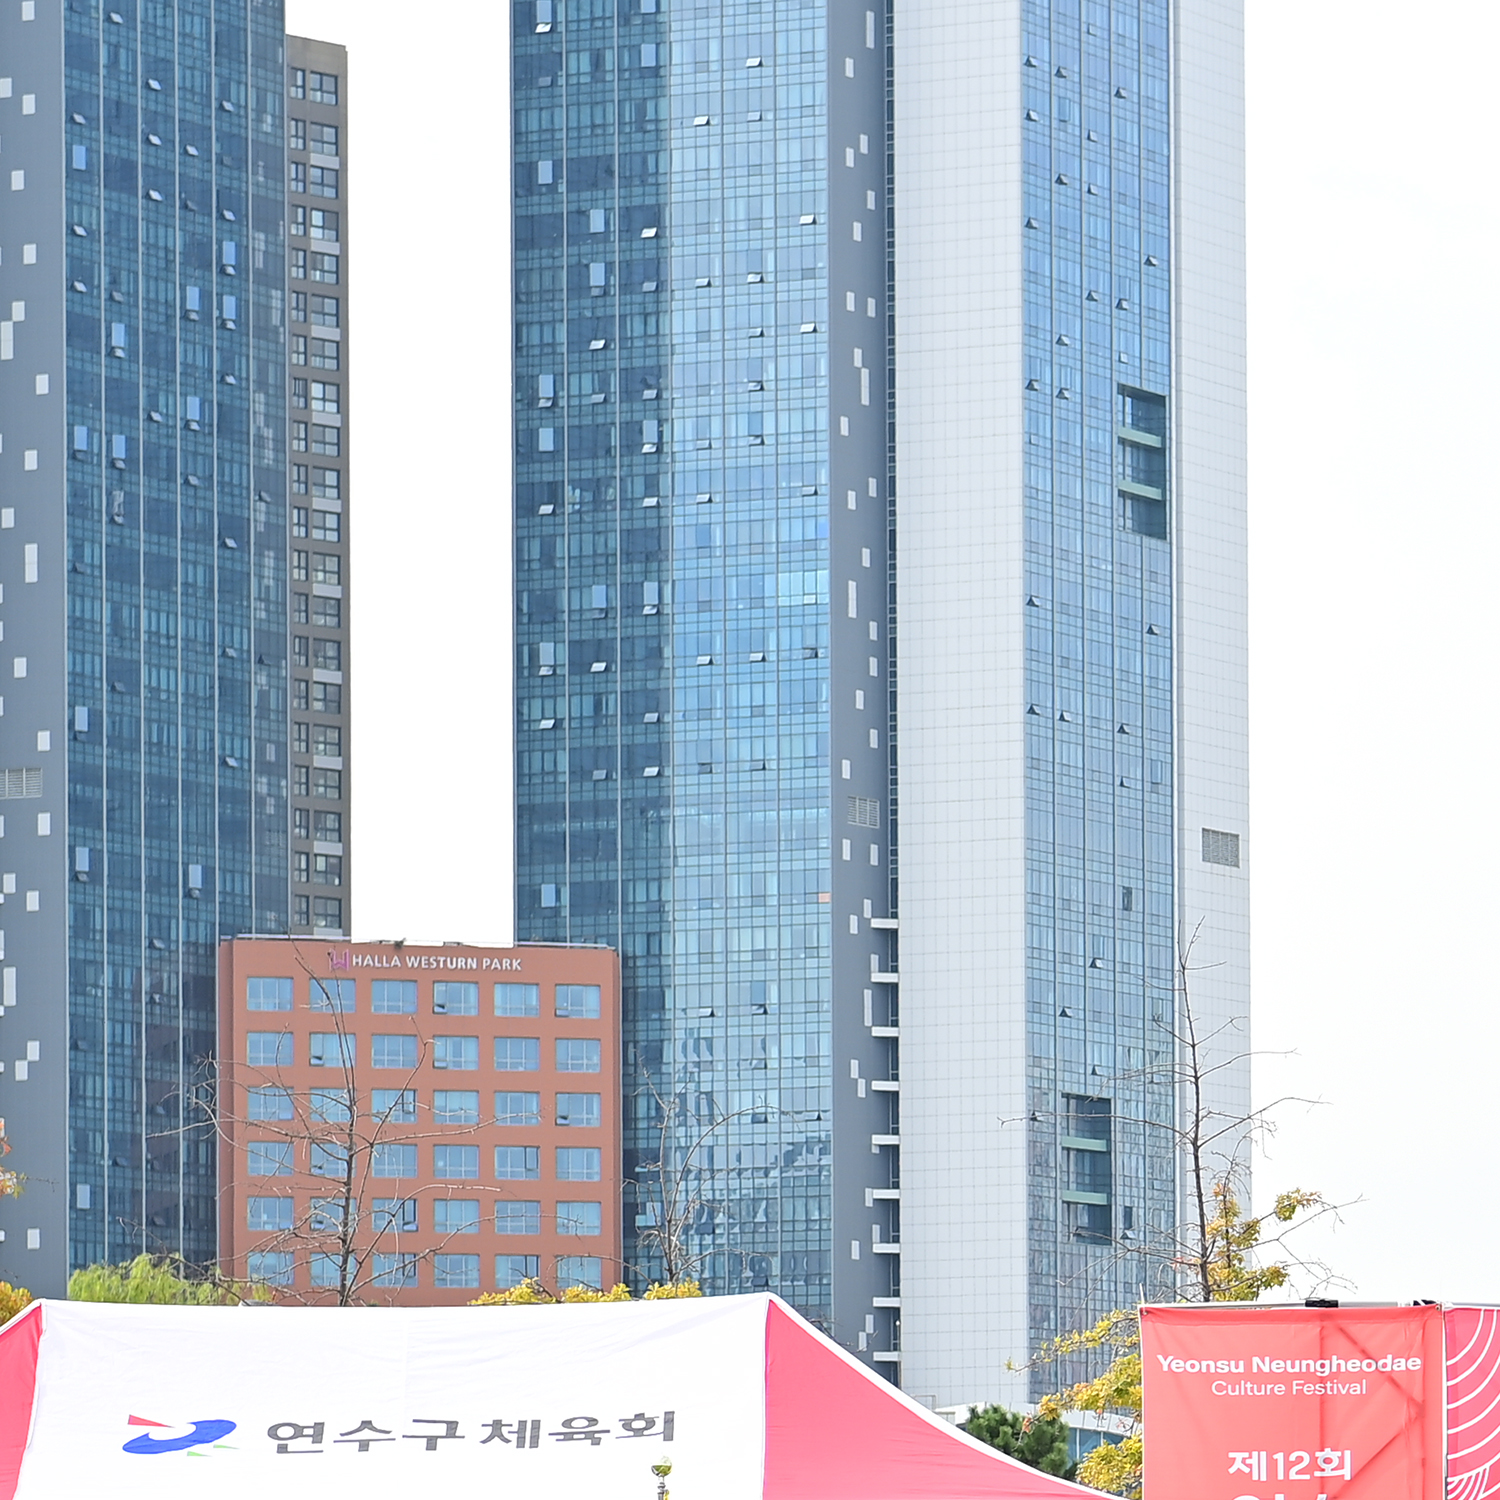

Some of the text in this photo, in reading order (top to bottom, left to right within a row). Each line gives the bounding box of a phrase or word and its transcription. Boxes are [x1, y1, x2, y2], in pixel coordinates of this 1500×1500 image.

[352, 954, 521, 971] HALLA WESTURN PARK
[1157, 1355, 1422, 1377] Yeonsu Neungheodae
[1211, 1379, 1367, 1396] Culture Festival
[1228, 1448, 1351, 1482] 제12회
